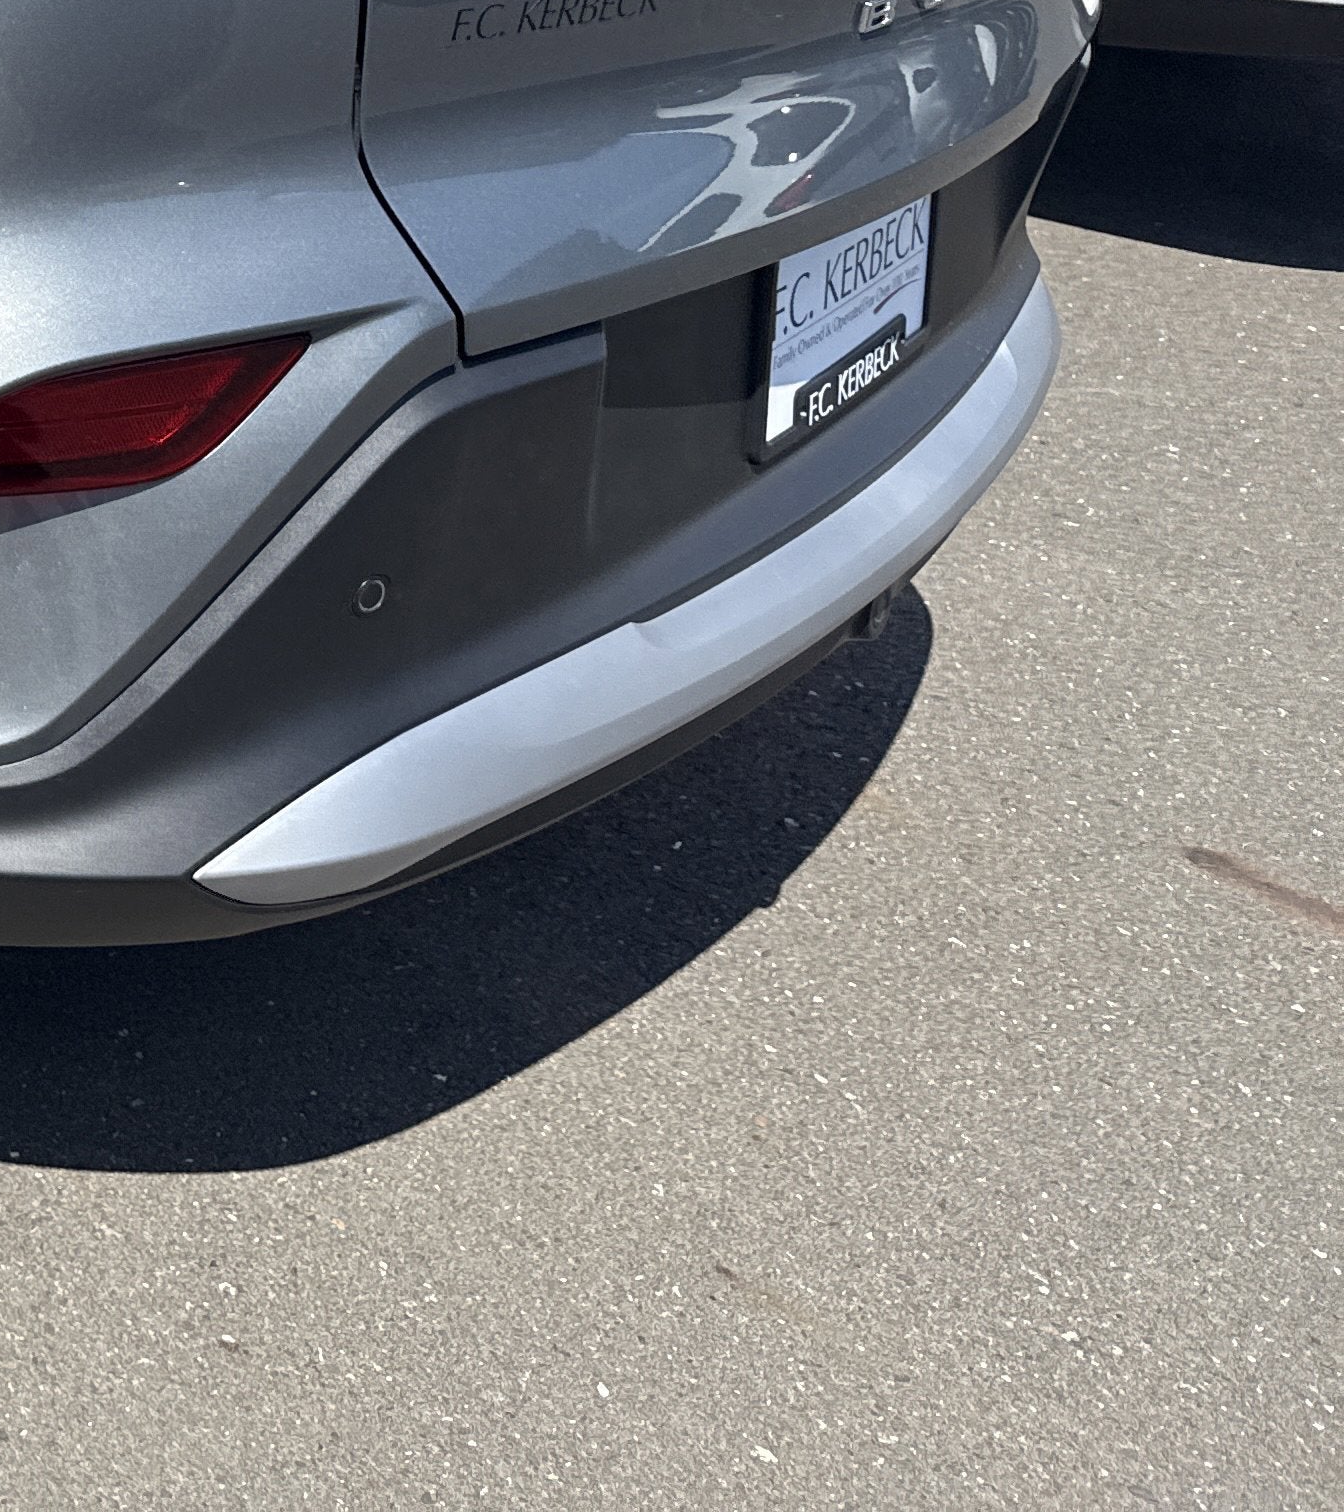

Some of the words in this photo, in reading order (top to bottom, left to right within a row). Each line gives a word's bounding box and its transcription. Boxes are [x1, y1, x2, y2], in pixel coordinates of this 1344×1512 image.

[450, 3, 506, 42] F.C.
[824, 198, 926, 310] KERBECK
[808, 381, 834, 427] F.C.
[837, 331, 901, 406] KERBECK
